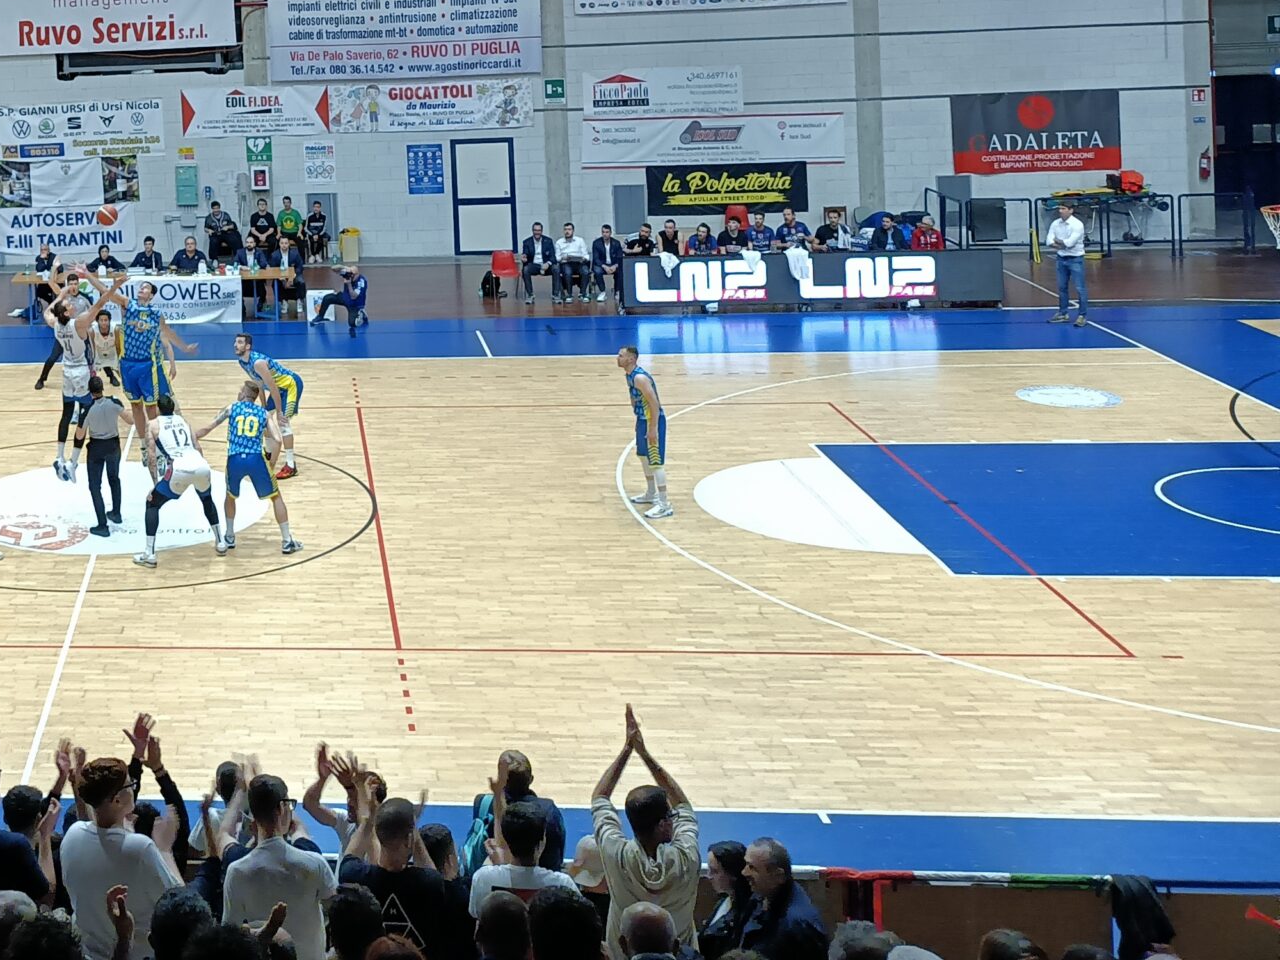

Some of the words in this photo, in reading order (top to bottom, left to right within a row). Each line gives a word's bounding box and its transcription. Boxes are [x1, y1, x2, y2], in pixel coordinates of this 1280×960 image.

[287, 1, 321, 14] impianti
[325, 0, 357, 11] elettrici
[385, 0, 390, 9] e
[288, 14, 366, 28] videosorveglianza
[378, 11, 437, 24] antintrusione
[450, 7, 518, 22] climatizzazione
[19, 20, 81, 47] Ruvo
[92, 14, 175, 44] Servizi
[178, 24, 208, 40] s.r.l.
[289, 29, 315, 41] cabine
[316, 28, 324, 40] di
[325, 26, 383, 39] trasformazione
[385, 27, 408, 38] mt-bt
[416, 24, 455, 37] domotica
[465, 22, 519, 35] automazione
[289, 50, 305, 62] Via
[308, 50, 320, 62] De
[323, 49, 344, 61] Palo
[346, 47, 385, 61] Saverio,
[387, 48, 399, 59] 62
[410, 44, 449, 58] RUVO
[453, 43, 467, 56] DI
[471, 41, 521, 56] PUGLIA
[290, 62, 326, 76] Tel./Fax
[329, 62, 347, 74] 080
[349, 60, 395, 74] 36.14.542
[407, 58, 522, 74] www.agostinoriccardi.it
[388, 84, 472, 100] GIOCATTOLI
[20, 105, 58, 115] GIANNI
[61, 104, 86, 114] URSI
[89, 103, 99, 112] di
[102, 101, 122, 111] Ursi
[126, 100, 159, 110] Nicola
[406, 102, 417, 110] da
[419, 100, 456, 109] Maurizio
[1033, 160, 1083, 168] TECNOLOGICI
[662, 173, 681, 193] la
[686, 171, 792, 194] Polpetteria
[37, 230, 122, 247] TARANTINI
[722, 288, 766, 300] PASS
[891, 285, 935, 297] PASS
[183, 300, 236, 308] CONSERVATIVO
[235, 415, 259, 437] 10
[171, 428, 190, 447] 12
